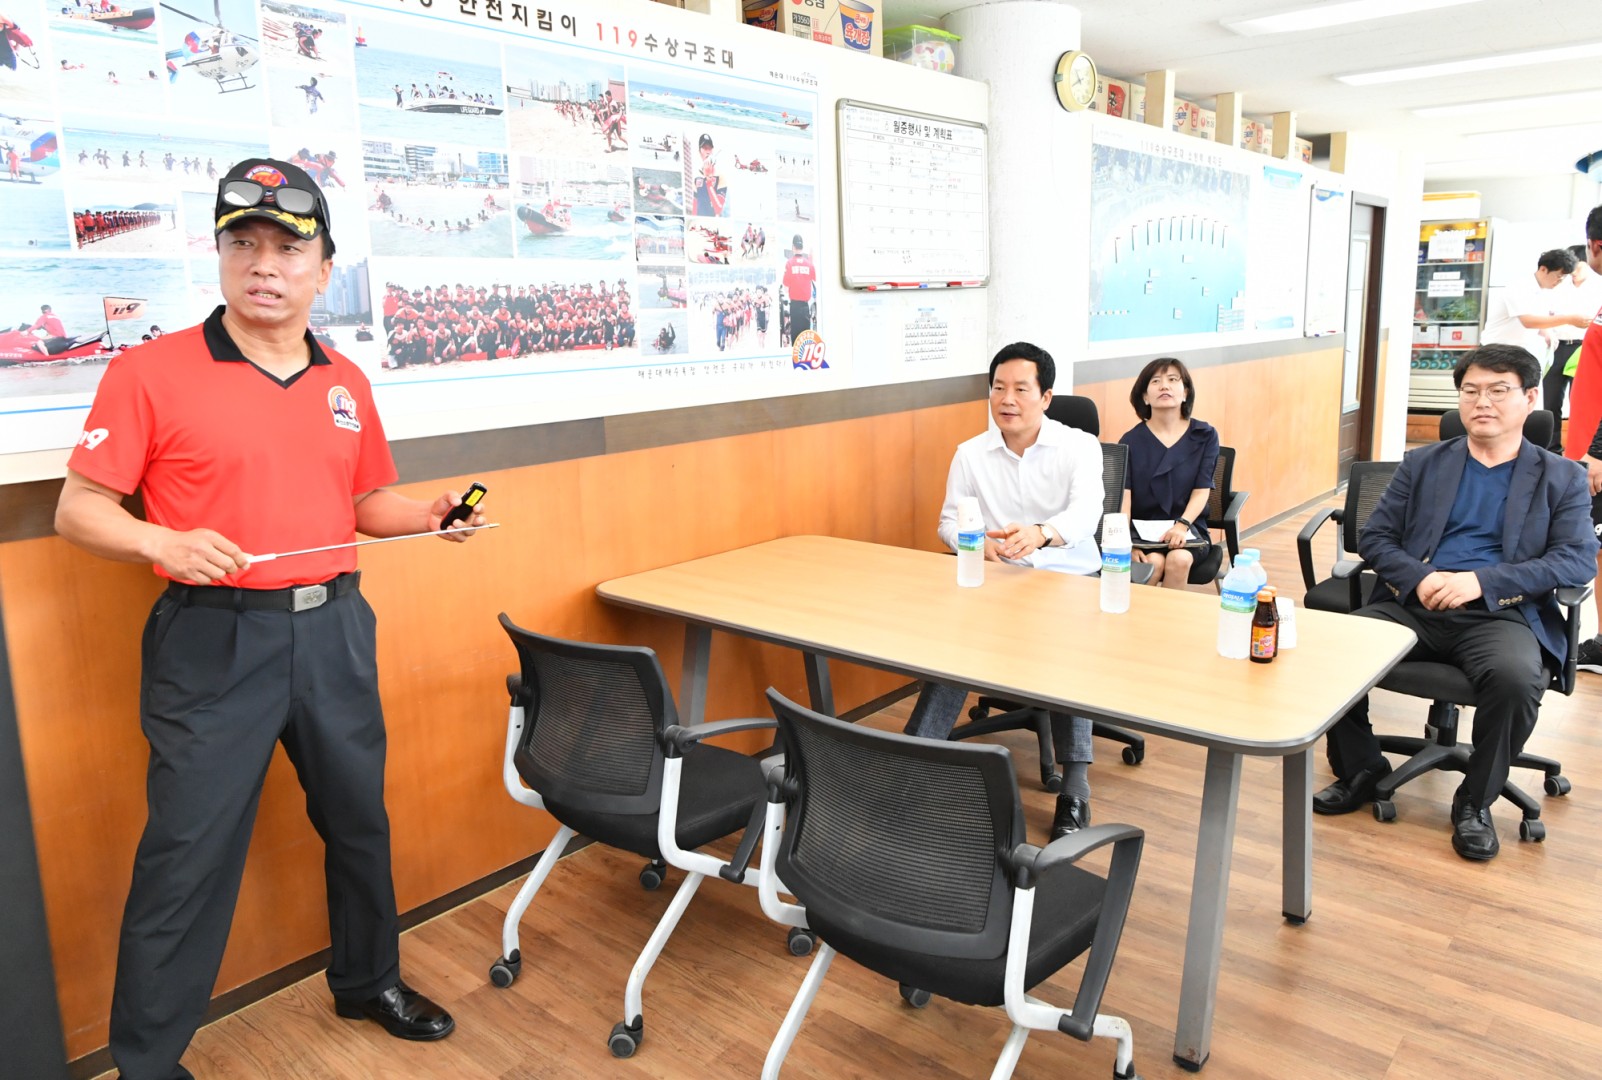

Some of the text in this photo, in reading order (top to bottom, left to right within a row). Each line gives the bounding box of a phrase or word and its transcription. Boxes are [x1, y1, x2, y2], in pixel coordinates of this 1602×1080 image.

[845, 22, 870, 46] 육개장
[893, 120, 921, 136] 월중행사
[924, 125, 930, 138] 및
[933, 127, 952, 141] 계획표
[800, 342, 826, 369] 119
